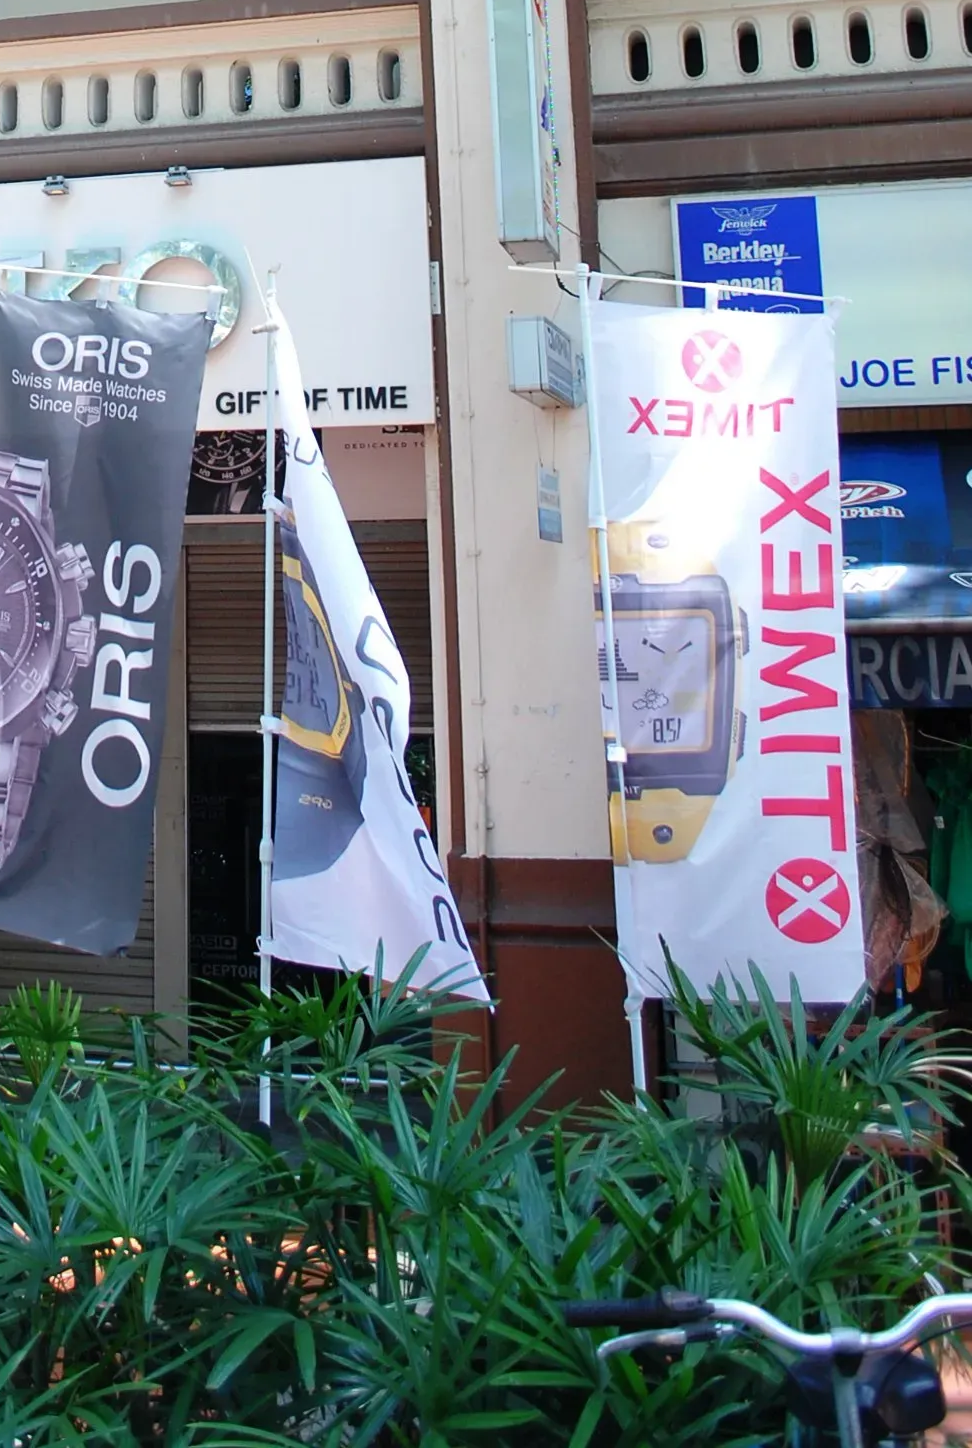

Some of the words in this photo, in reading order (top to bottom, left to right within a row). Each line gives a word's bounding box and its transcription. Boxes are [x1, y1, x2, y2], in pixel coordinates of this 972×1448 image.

[718, 217, 768, 233] fenwick
[702, 240, 787, 266] Berkley
[31, 332, 153, 380] ORIS
[11, 368, 52, 390] Swiss
[57, 375, 103, 394] Made
[105, 378, 166, 403] Watches
[840, 358, 917, 388] JOE
[931, 355, 972, 386] FI
[29, 393, 73, 414] Since
[102, 400, 138, 422] 1904
[215, 389, 279, 414] GIF
[337, 385, 408, 410] TIME
[344, 440, 408, 450] DEDICATED
[81, 540, 162, 808] ORIS
[850, 634, 972, 702] RCIA
[191, 935, 235, 949] ASIO
